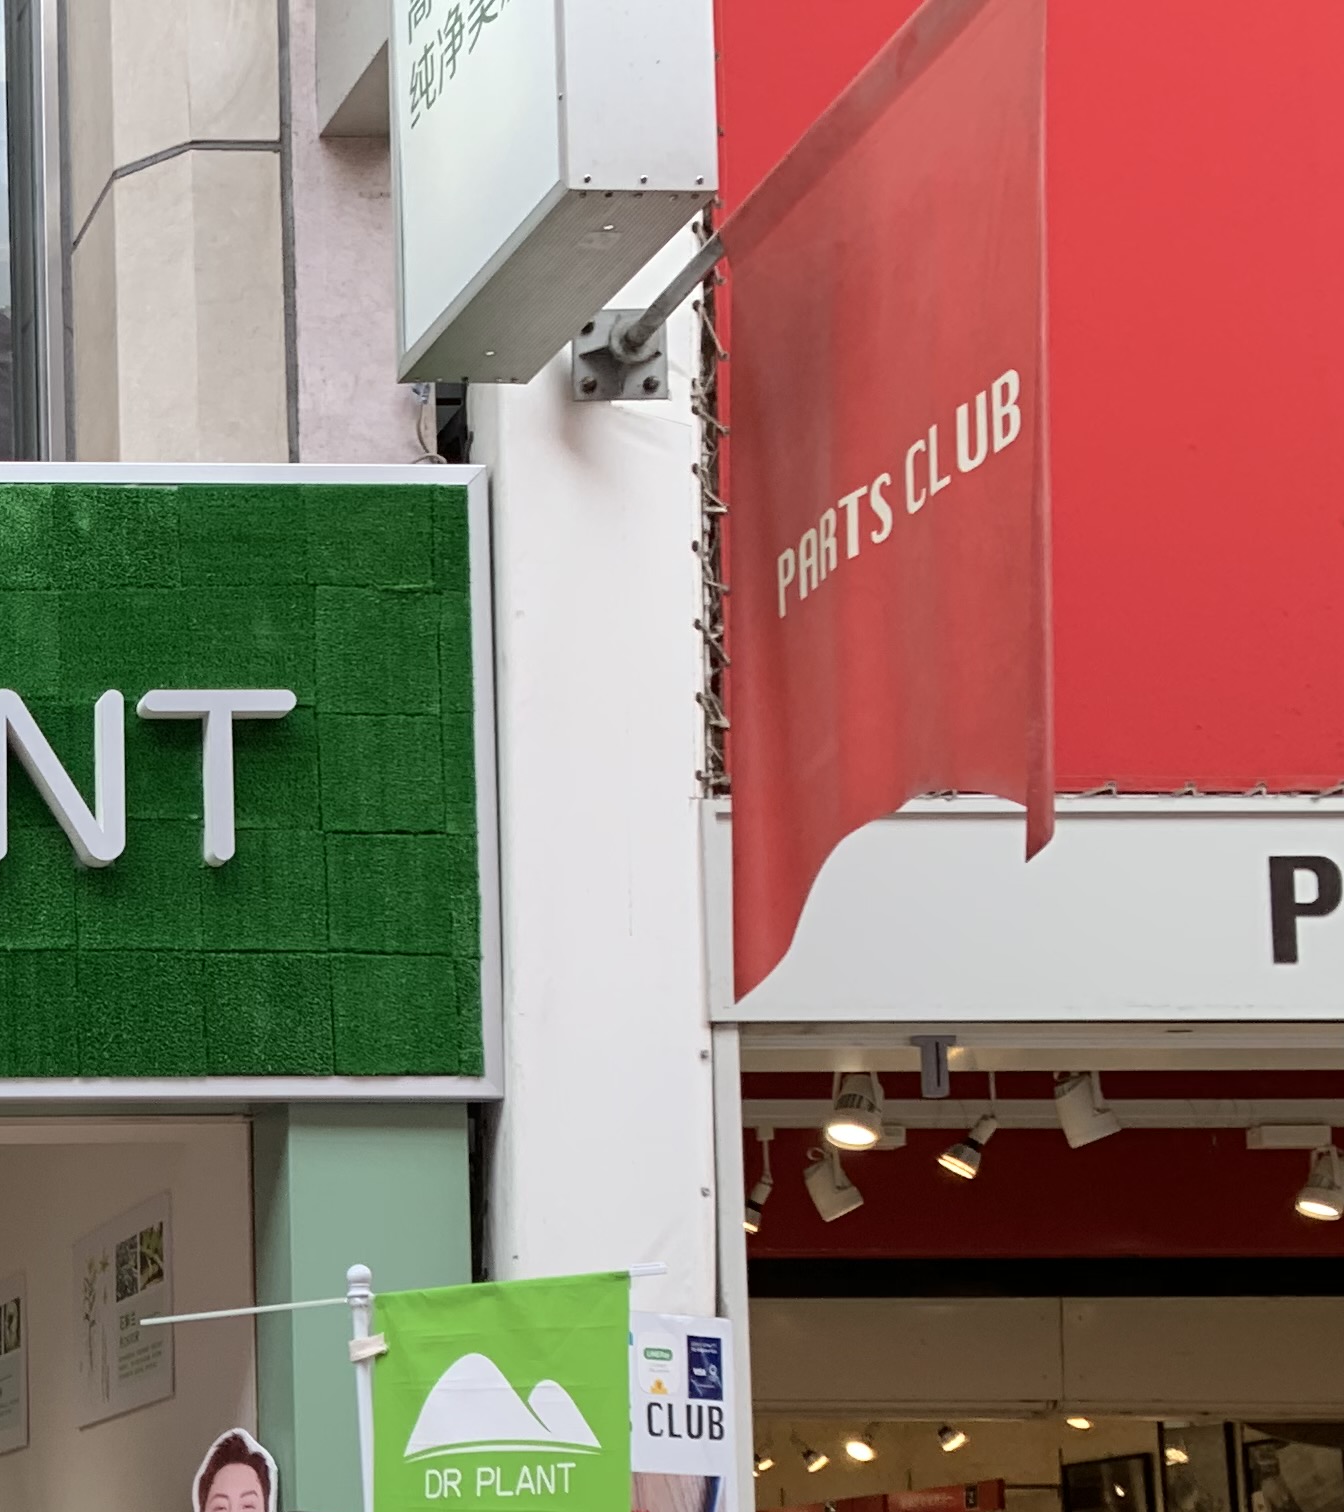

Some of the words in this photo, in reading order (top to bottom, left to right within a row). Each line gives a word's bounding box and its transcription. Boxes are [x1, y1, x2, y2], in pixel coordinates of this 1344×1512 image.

[409, 0, 510, 130] 纯净美
[777, 473, 895, 619] PARTS
[904, 368, 1023, 516] CLUB
[1268, 855, 1344, 965] P
[646, 1401, 725, 1441] CLUB
[425, 1467, 463, 1499] DR
[476, 1462, 577, 1498] PLANT
